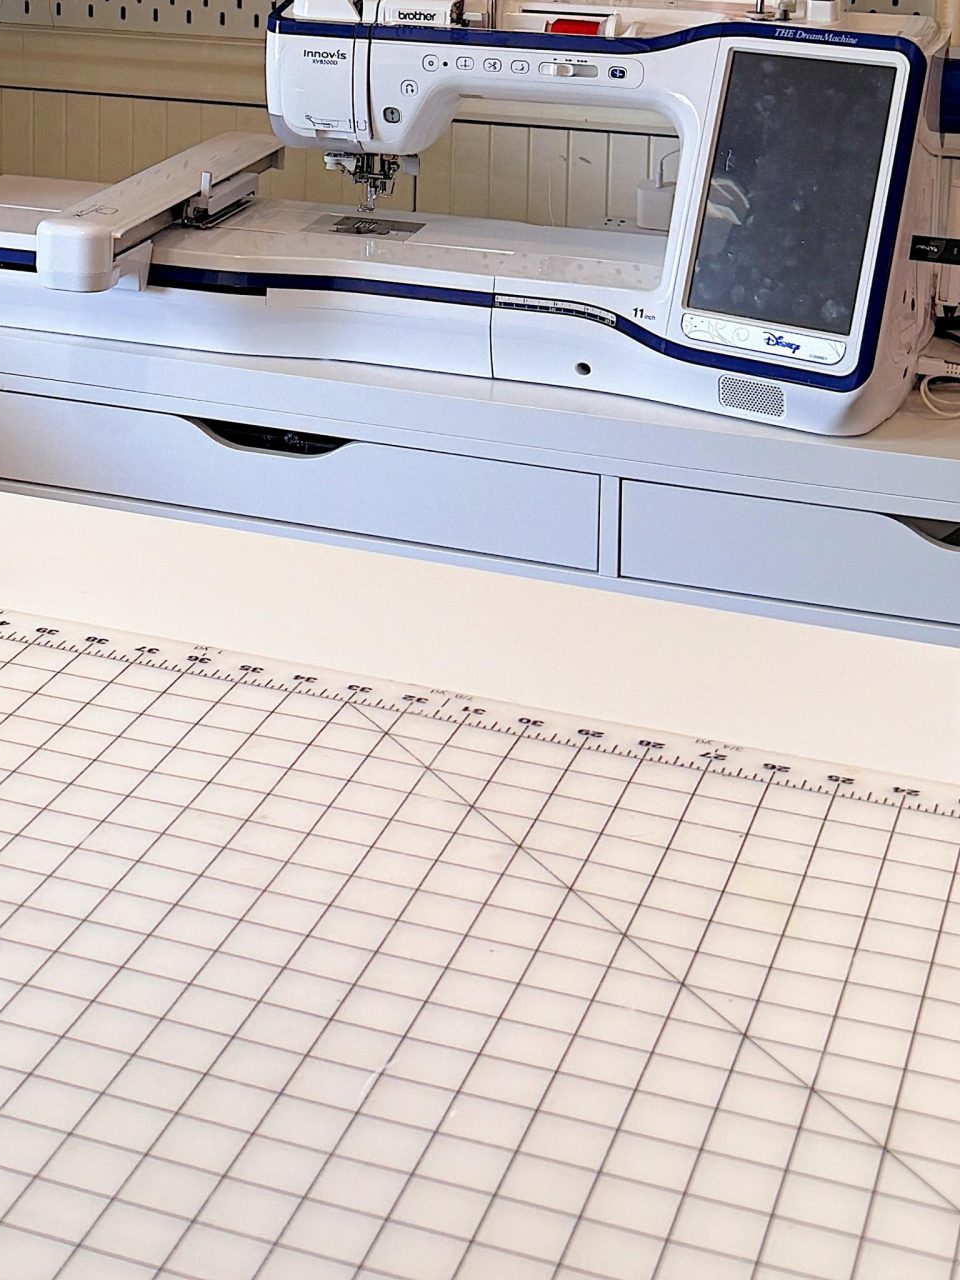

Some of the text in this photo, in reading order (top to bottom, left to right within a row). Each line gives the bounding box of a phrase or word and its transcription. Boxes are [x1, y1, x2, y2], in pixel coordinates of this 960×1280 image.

[398, 11, 437, 21] brother
[774, 28, 796, 38] THE
[632, 307, 644, 319] 11
[763, 331, 801, 355] Disney
[35, 627, 60, 635] 39
[85, 636, 110, 645] 38
[134, 646, 160, 654] 37
[186, 655, 212, 664] 36
[239, 664, 265, 674] 35
[292, 674, 318, 683] 34
[347, 684, 373, 693] 33
[402, 694, 429, 704] 32
[462, 706, 487, 715] 31
[518, 717, 545, 727] 30
[577, 728, 605, 738] 29
[637, 739, 666, 750] 28
[698, 751, 728, 761] 27
[762, 762, 791, 773] 26
[827, 774, 856, 785] 25
[893, 786, 921, 797] 24
